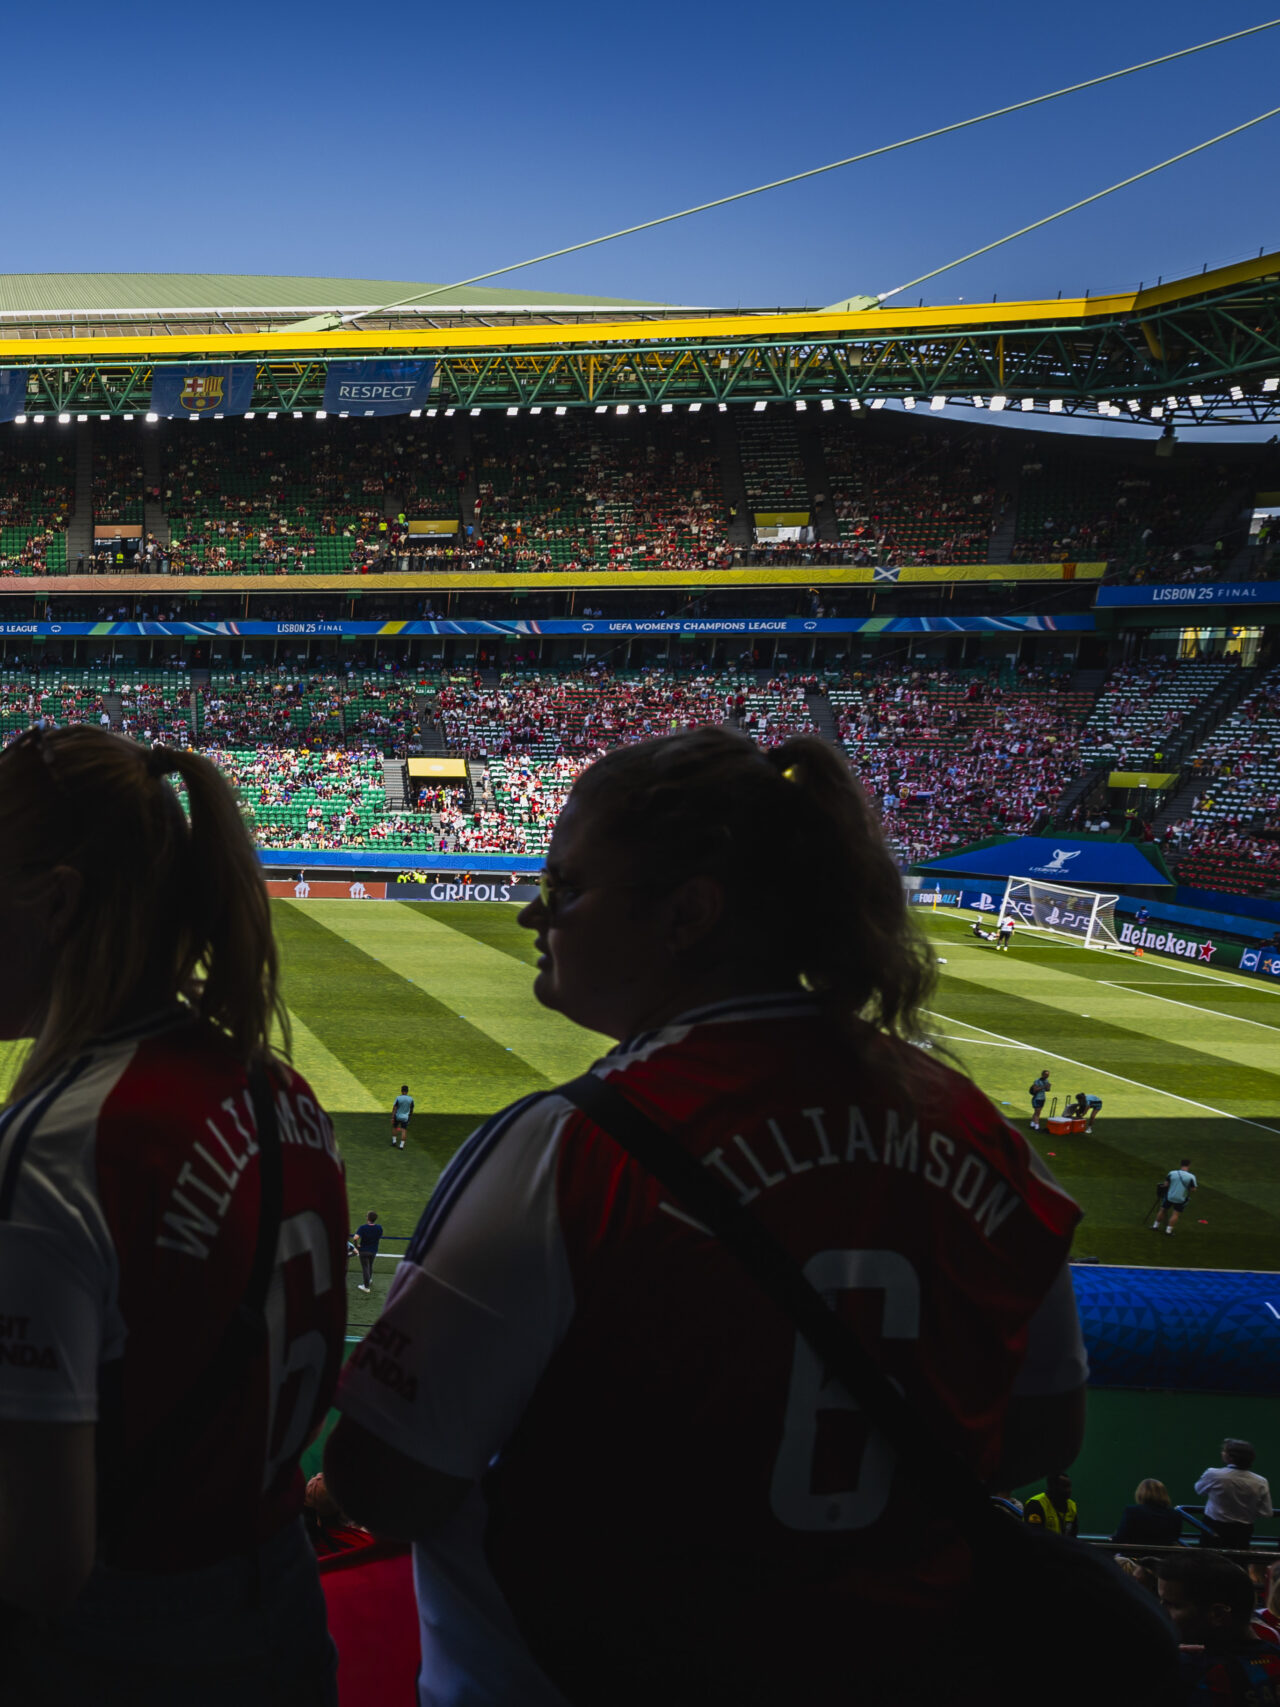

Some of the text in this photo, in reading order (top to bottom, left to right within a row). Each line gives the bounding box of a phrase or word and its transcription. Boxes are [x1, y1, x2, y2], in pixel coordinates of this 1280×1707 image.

[340, 385, 416, 398] RESPECT
[1152, 587, 1257, 601] LISBON 25 FINAL
[6, 625, 38, 633] LEAGUE
[277, 624, 305, 633] LISBON
[305, 624, 316, 633] 25
[609, 622, 787, 631] UEFA WOMEN'S CHAMPIONS LEAGUE
[430, 884, 510, 901] GRIFOLS
[912, 893, 958, 904] #FOOTBALL
[1061, 914, 1092, 931] PS5
[1120, 923, 1199, 958] Heineken
[768, 1249, 922, 1533] 6
